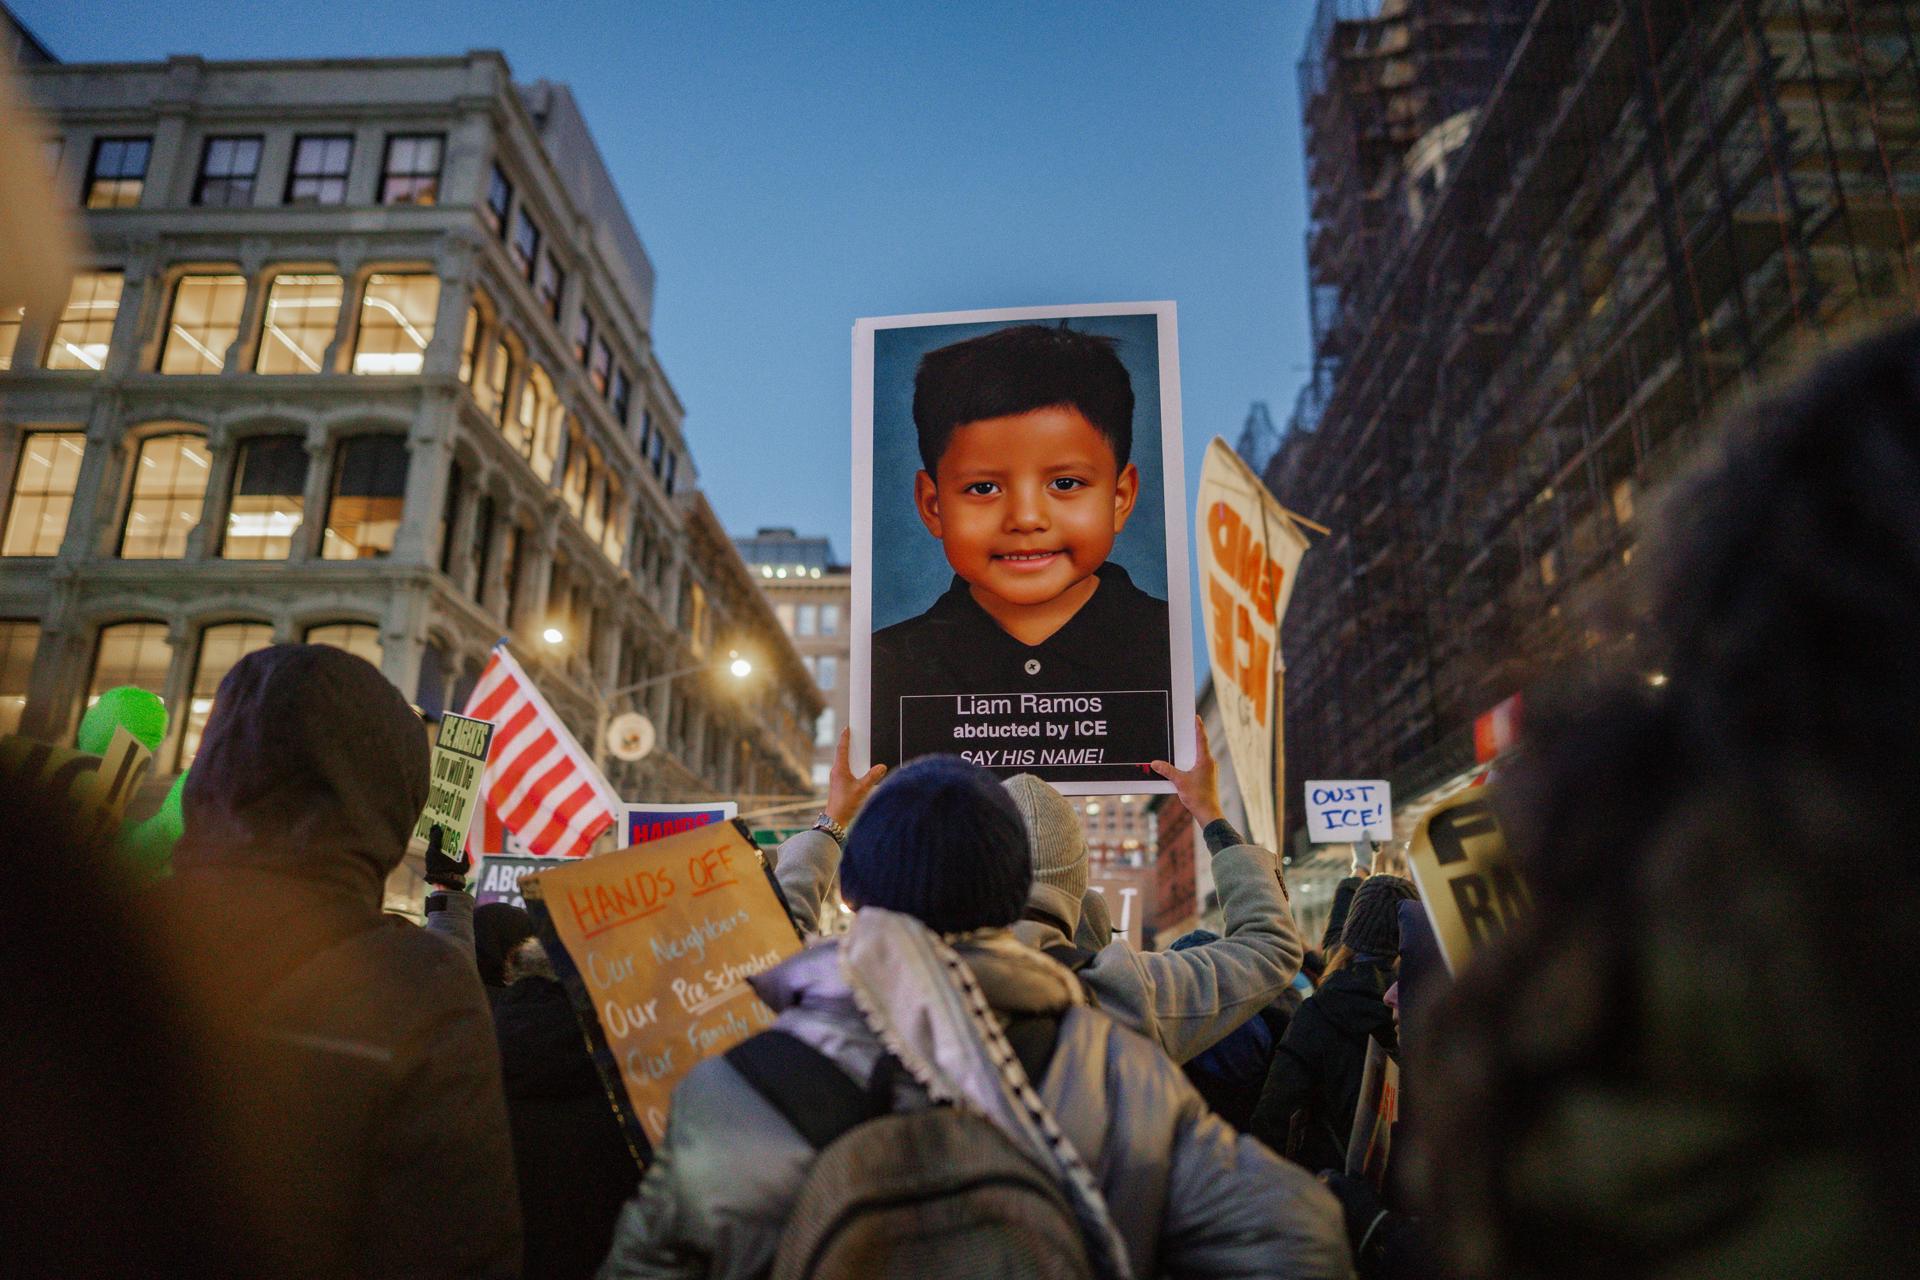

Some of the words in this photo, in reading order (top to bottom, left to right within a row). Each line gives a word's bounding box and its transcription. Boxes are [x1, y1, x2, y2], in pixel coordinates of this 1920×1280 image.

[957, 695, 1011, 715] Liam
[1020, 694, 1103, 714] Ramos
[451, 718, 489, 757] AGENTS
[953, 722, 1040, 739] abducted
[1046, 722, 1069, 740] by
[1075, 720, 1108, 736] ICE
[434, 751, 450, 782] You
[447, 756, 467, 787] will
[461, 760, 475, 791] be
[960, 750, 998, 766] SAY
[1002, 750, 1035, 765] HIS
[1040, 749, 1104, 765] NAME!
[451, 789, 466, 823] for
[1312, 785, 1375, 806] OUST
[1321, 803, 1382, 829] ICE!
[568, 867, 676, 933] HANDS
[688, 844, 733, 887] OFF
[587, 950, 634, 990] Our
[605, 999, 658, 1038] Our
[627, 1046, 674, 1086] Our
[687, 1010, 749, 1052] Family
